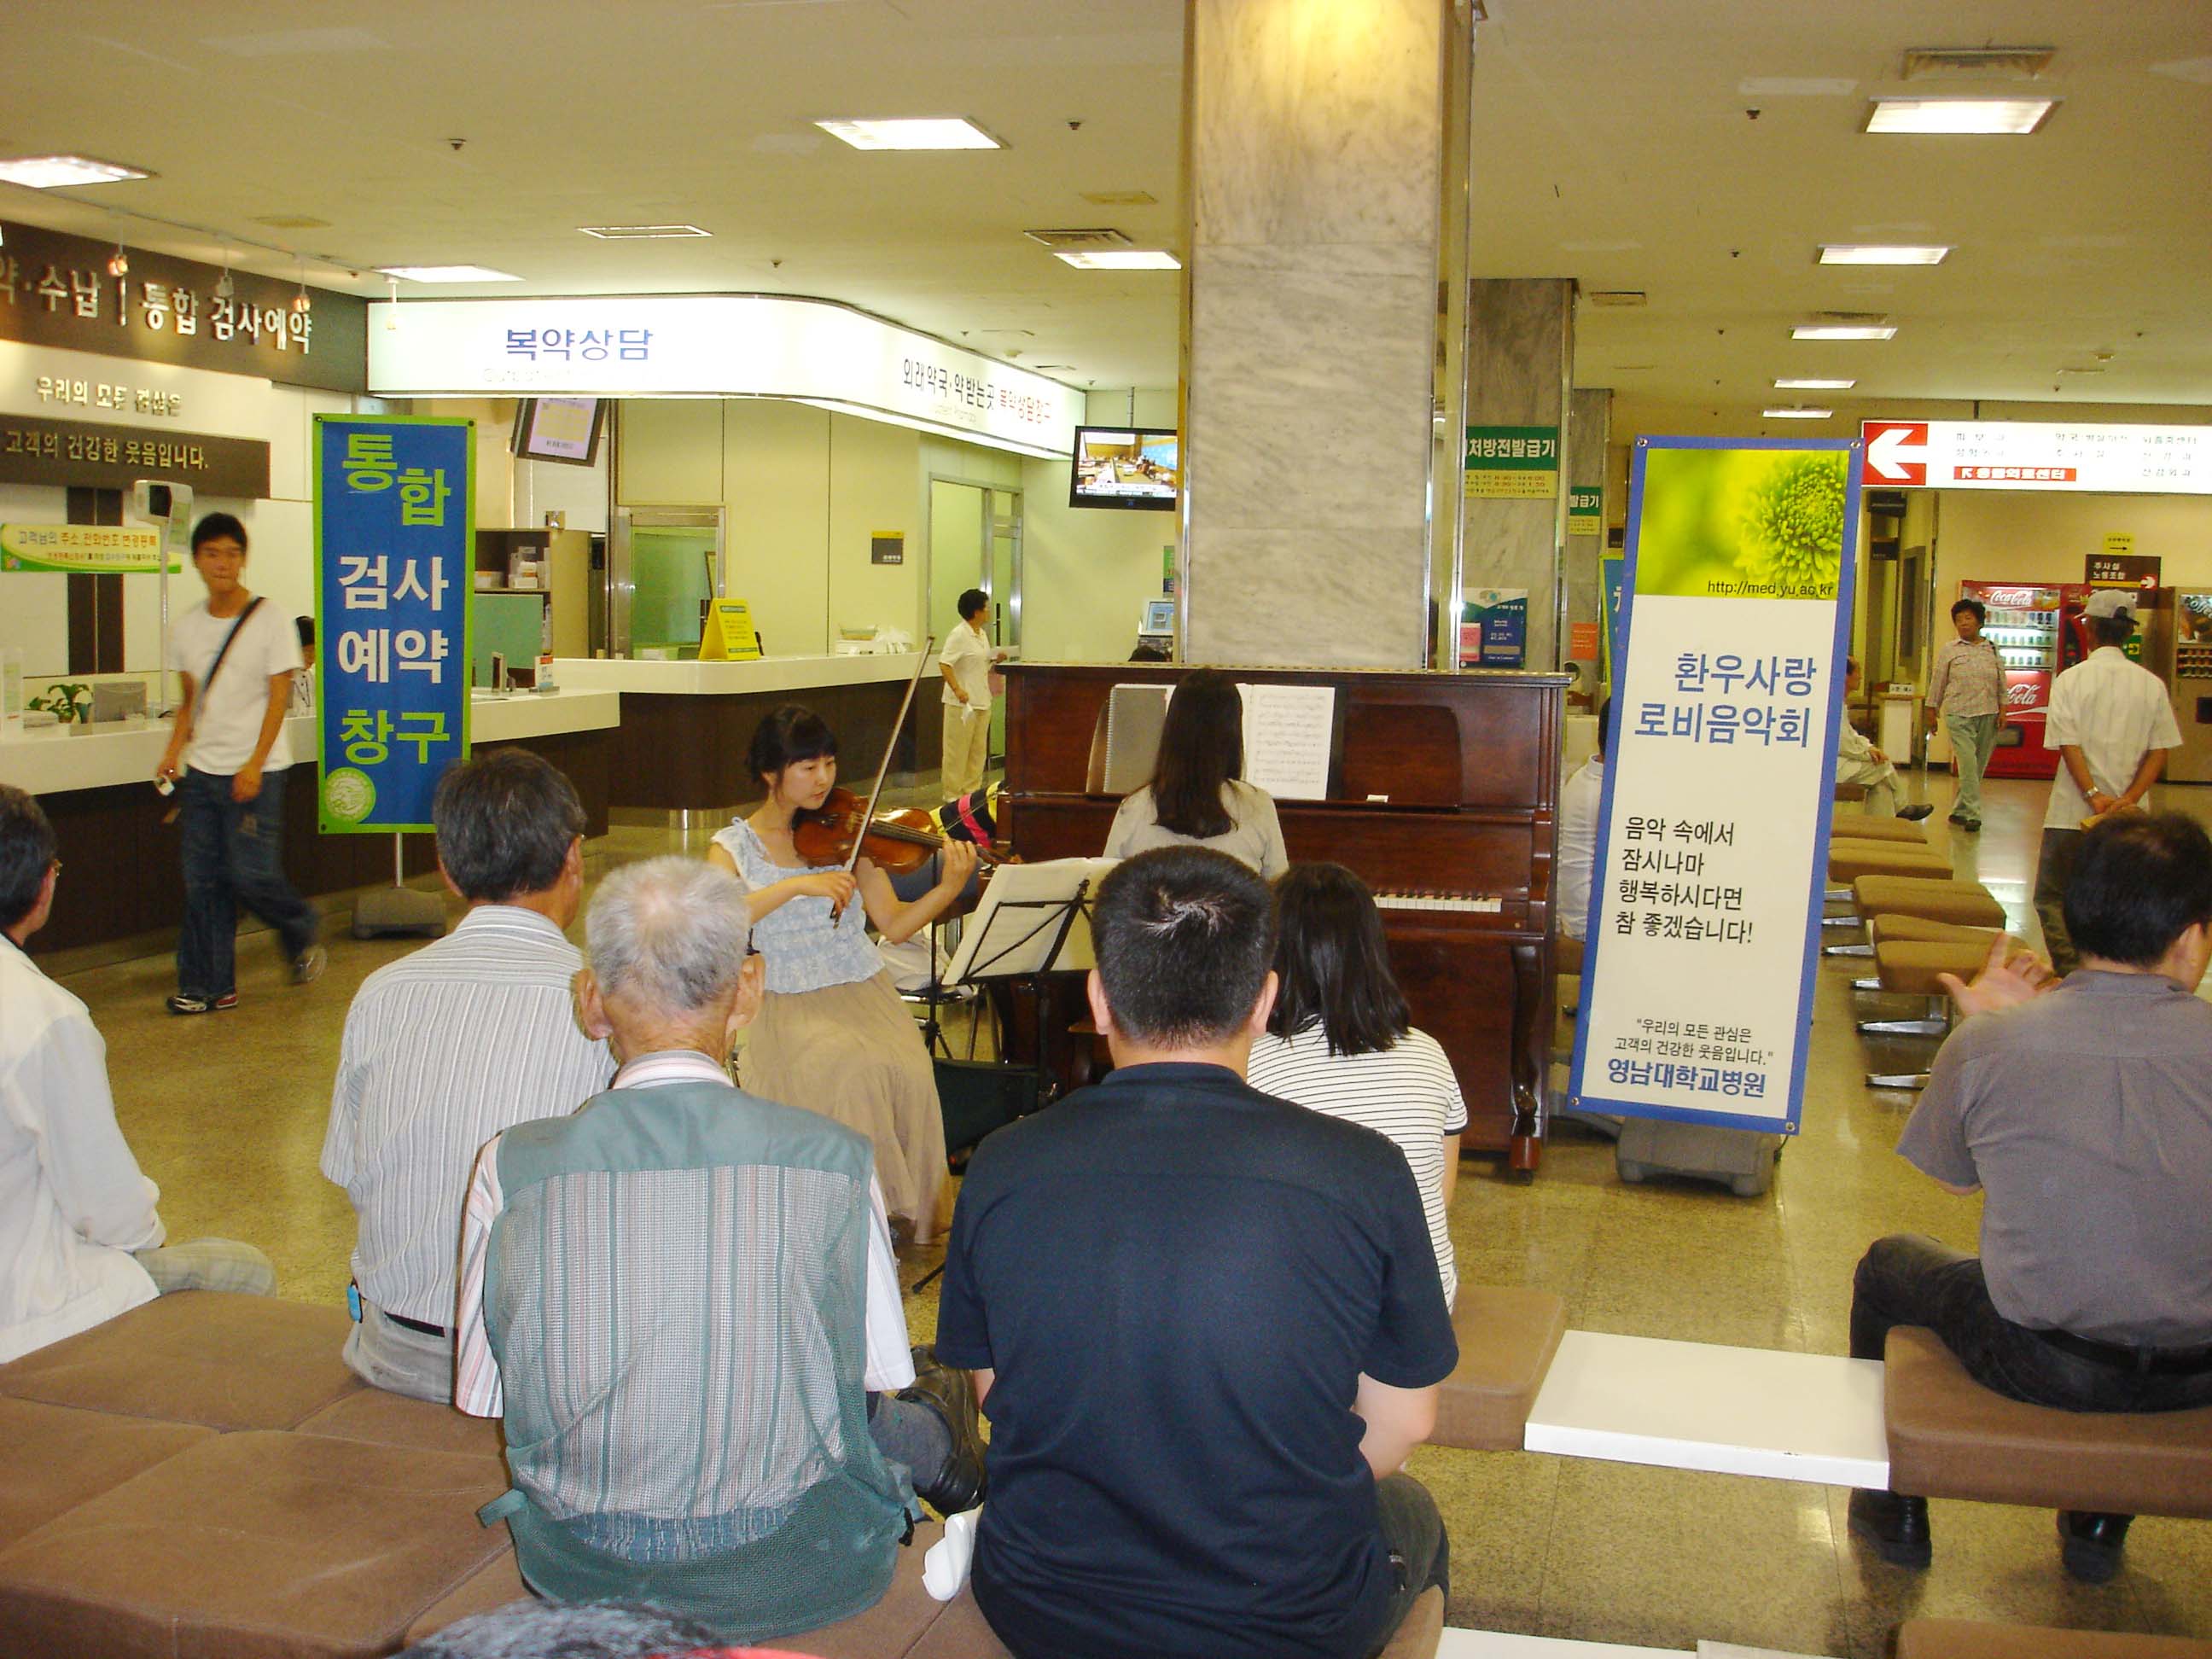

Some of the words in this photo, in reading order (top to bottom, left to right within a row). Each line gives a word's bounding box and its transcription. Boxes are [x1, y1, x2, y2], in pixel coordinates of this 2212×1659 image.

[142, 282, 200, 335] 통합
[211, 295, 312, 354] 검사예약
[506, 329, 654, 361] 복약상담
[38, 376, 88, 405] 우리의
[6, 429, 58, 459] 고객의
[68, 434, 118, 463] 건강한
[125, 440, 208, 470] 웃음입니다.
[1468, 438, 1556, 458] 처방전발급기
[342, 434, 451, 527] 통합
[338, 555, 450, 611] 검사
[1707, 579, 1834, 597] http://med.yu.ac.kr
[338, 628, 450, 684] 예약
[1674, 653, 1817, 696] 환우사랑
[341, 709, 451, 765] 창구
[1634, 702, 1810, 748] 로비음악회
[1625, 816, 1667, 841] 음악
[1673, 819, 1734, 847] 속에서
[1621, 847, 1705, 876] 잠시나마
[1619, 879, 1743, 911] 행복하시다면
[1615, 911, 1636, 935] 참
[1643, 912, 1753, 944] 좋겠습니다!
[1614, 1037, 1652, 1054] 고객의
[1656, 1040, 1694, 1058] 건강한
[1683, 1022, 1709, 1039] 모든
[1713, 1026, 1752, 1044] 관심은
[1608, 1058, 1767, 1098] 영남대학교병원
